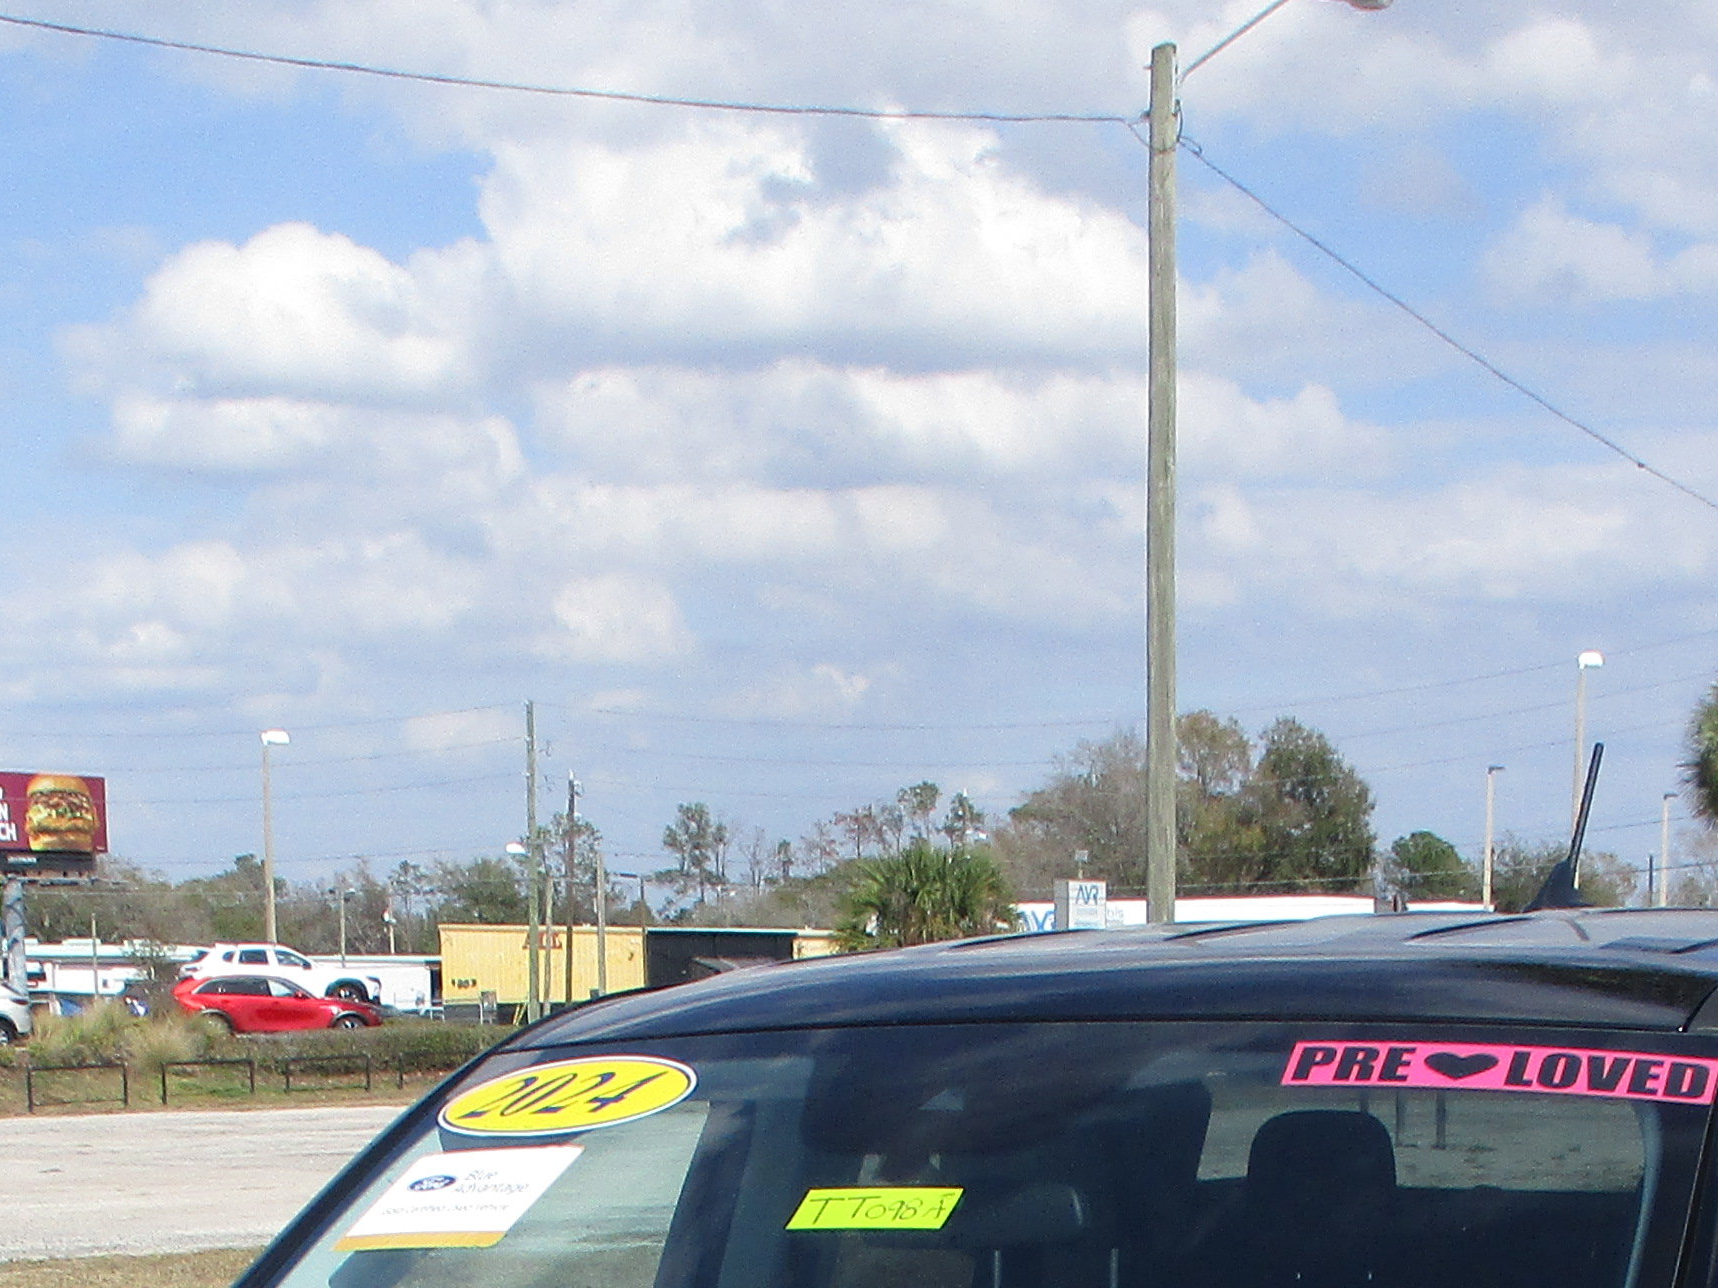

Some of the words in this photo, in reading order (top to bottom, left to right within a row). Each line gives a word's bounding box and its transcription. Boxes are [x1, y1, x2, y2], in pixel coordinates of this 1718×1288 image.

[457, 1070, 669, 1121] 2024
[1290, 1046, 1418, 1082] PRE
[1503, 1051, 1710, 1099] LOVED
